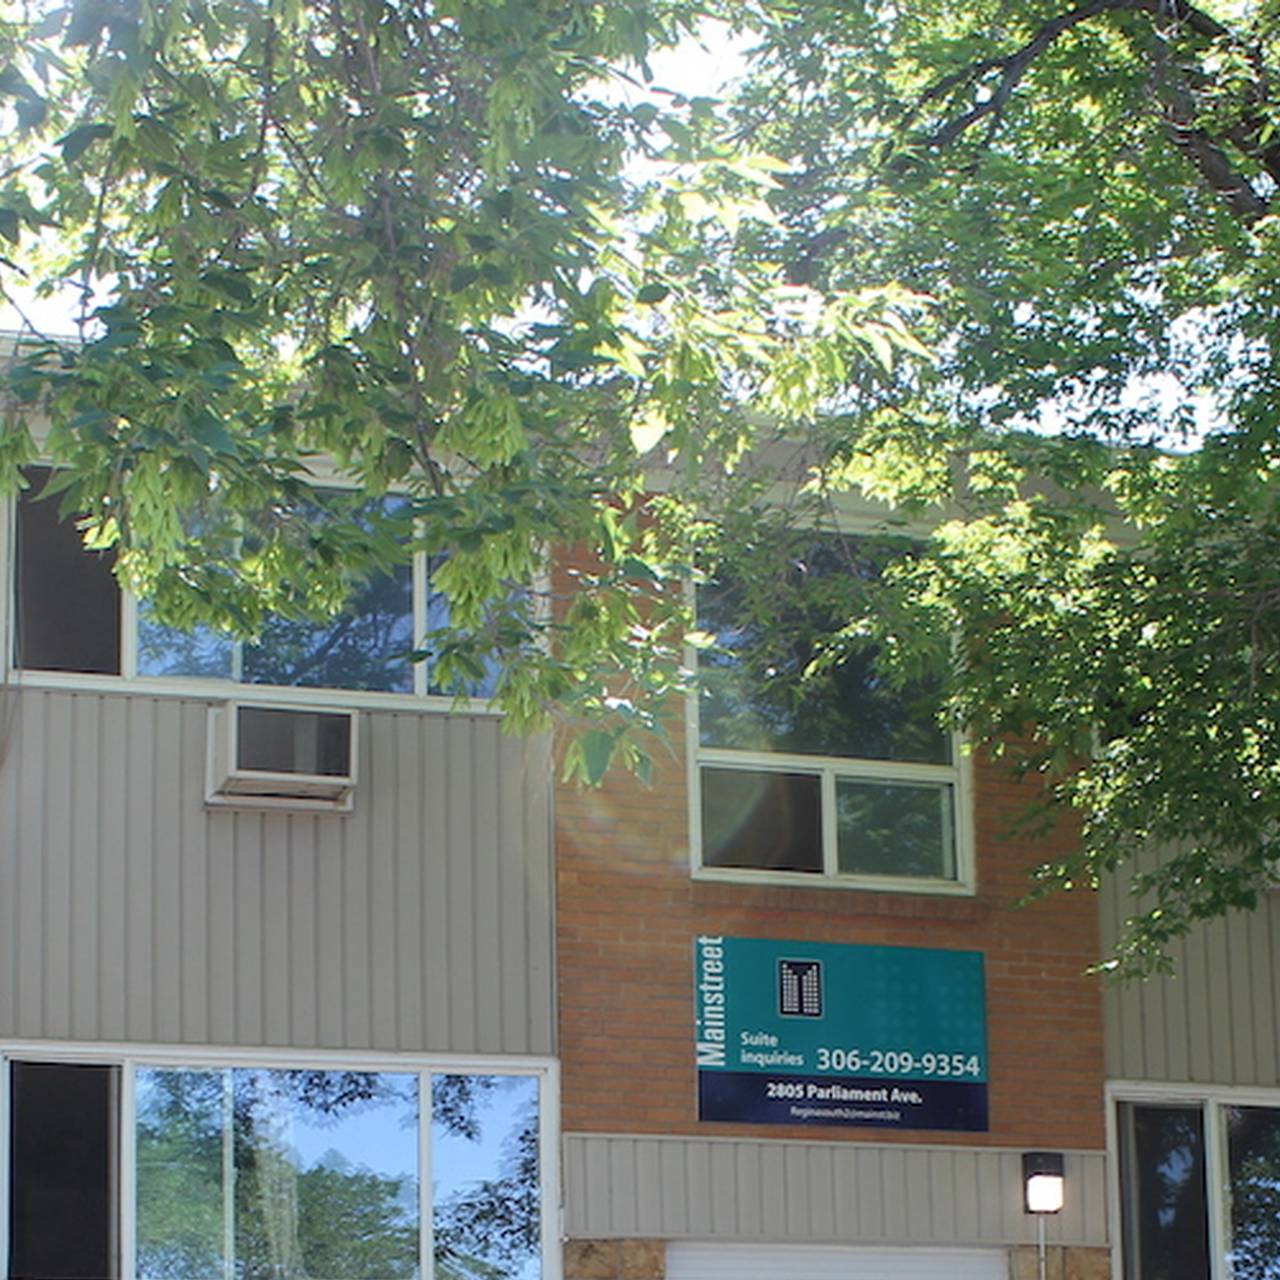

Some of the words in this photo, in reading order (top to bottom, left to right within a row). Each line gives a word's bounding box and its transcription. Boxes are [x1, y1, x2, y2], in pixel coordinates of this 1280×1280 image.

[696, 935, 726, 1067] Mainstreet
[740, 1031, 779, 1047] Suite
[816, 1048, 980, 1077] 306-209-9354
[767, 1082, 804, 1100] 2805
[807, 1084, 889, 1103] Parliament
[890, 1087, 923, 1104] Ave.
